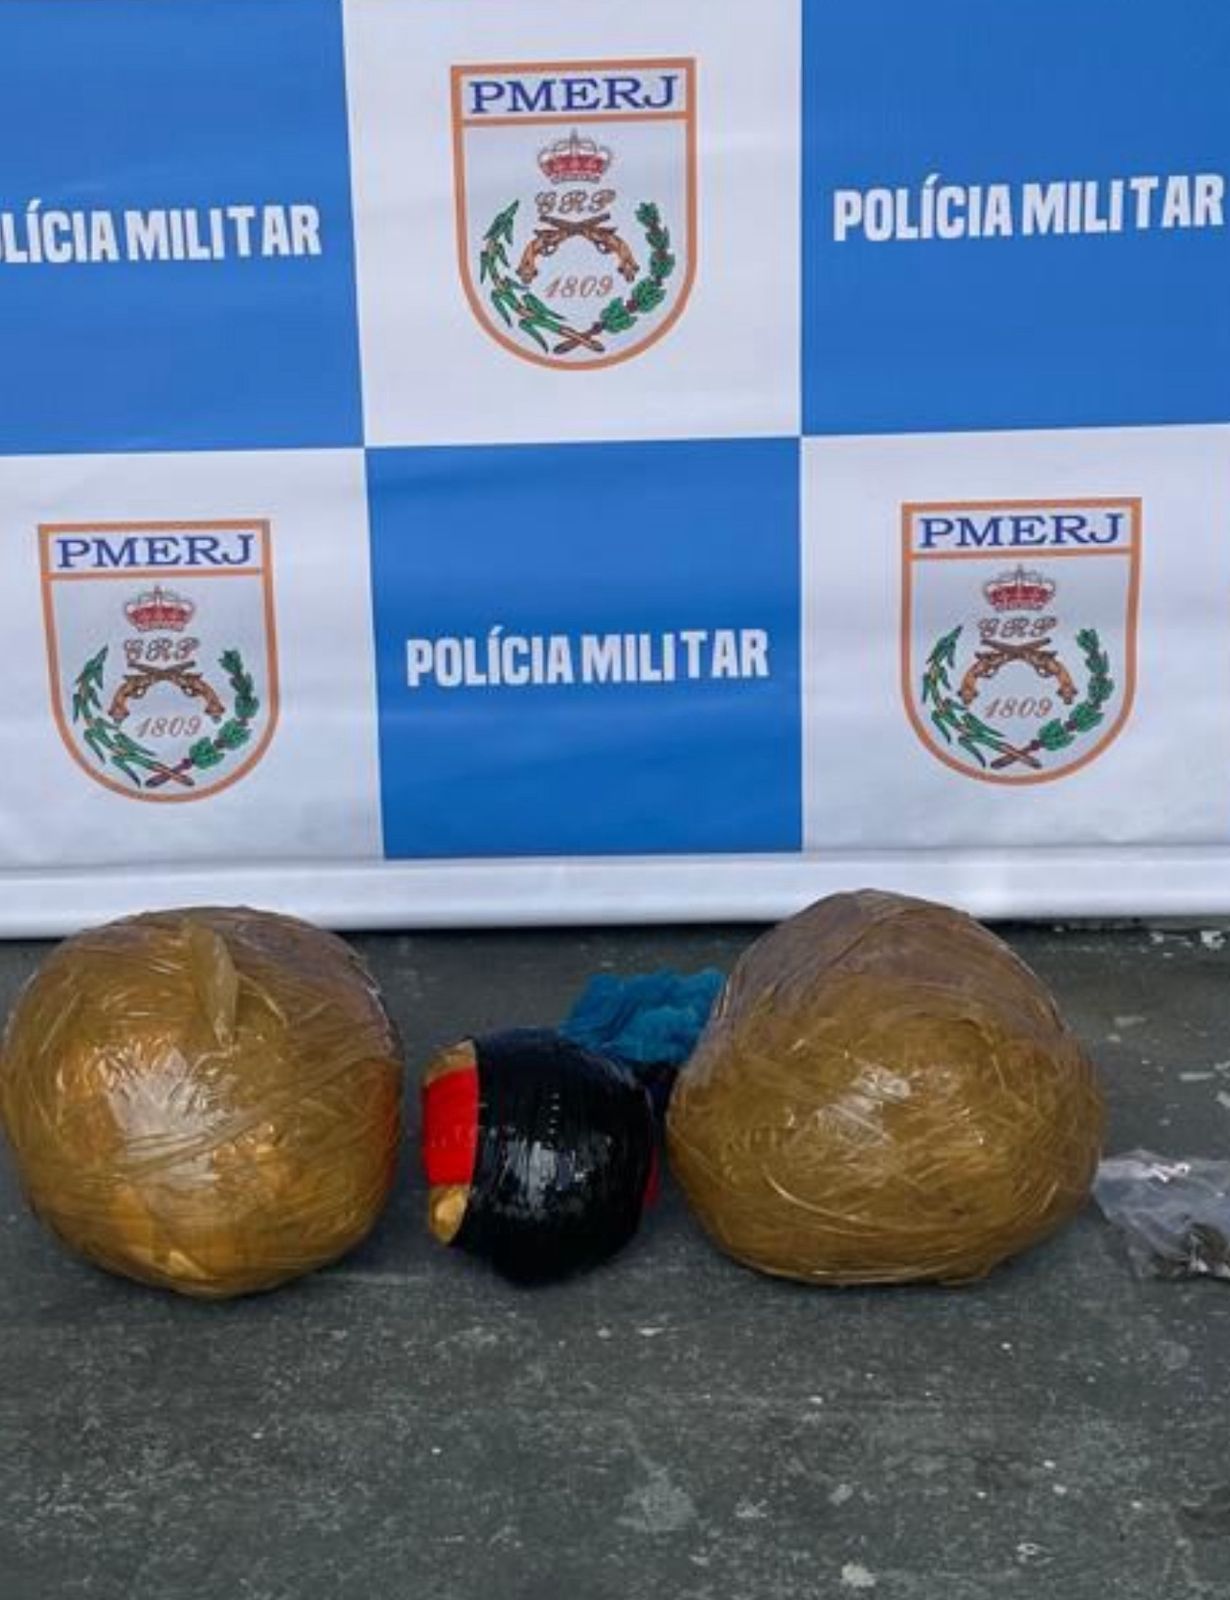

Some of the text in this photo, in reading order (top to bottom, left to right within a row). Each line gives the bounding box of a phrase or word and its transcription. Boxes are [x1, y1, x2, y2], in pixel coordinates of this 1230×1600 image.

[470, 75, 678, 113] PMERJ
[833, 173, 1225, 242] POLÍCIA MILITAR
[0, 199, 322, 263] LÍCIA MILITAR
[544, 276, 614, 299] 1809
[921, 513, 1123, 548] PMERJ
[56, 534, 254, 568] PMERJ
[407, 626, 769, 687] POLÍCIA MILITAR
[983, 697, 1053, 719] 1809
[137, 715, 201, 738] 1809
